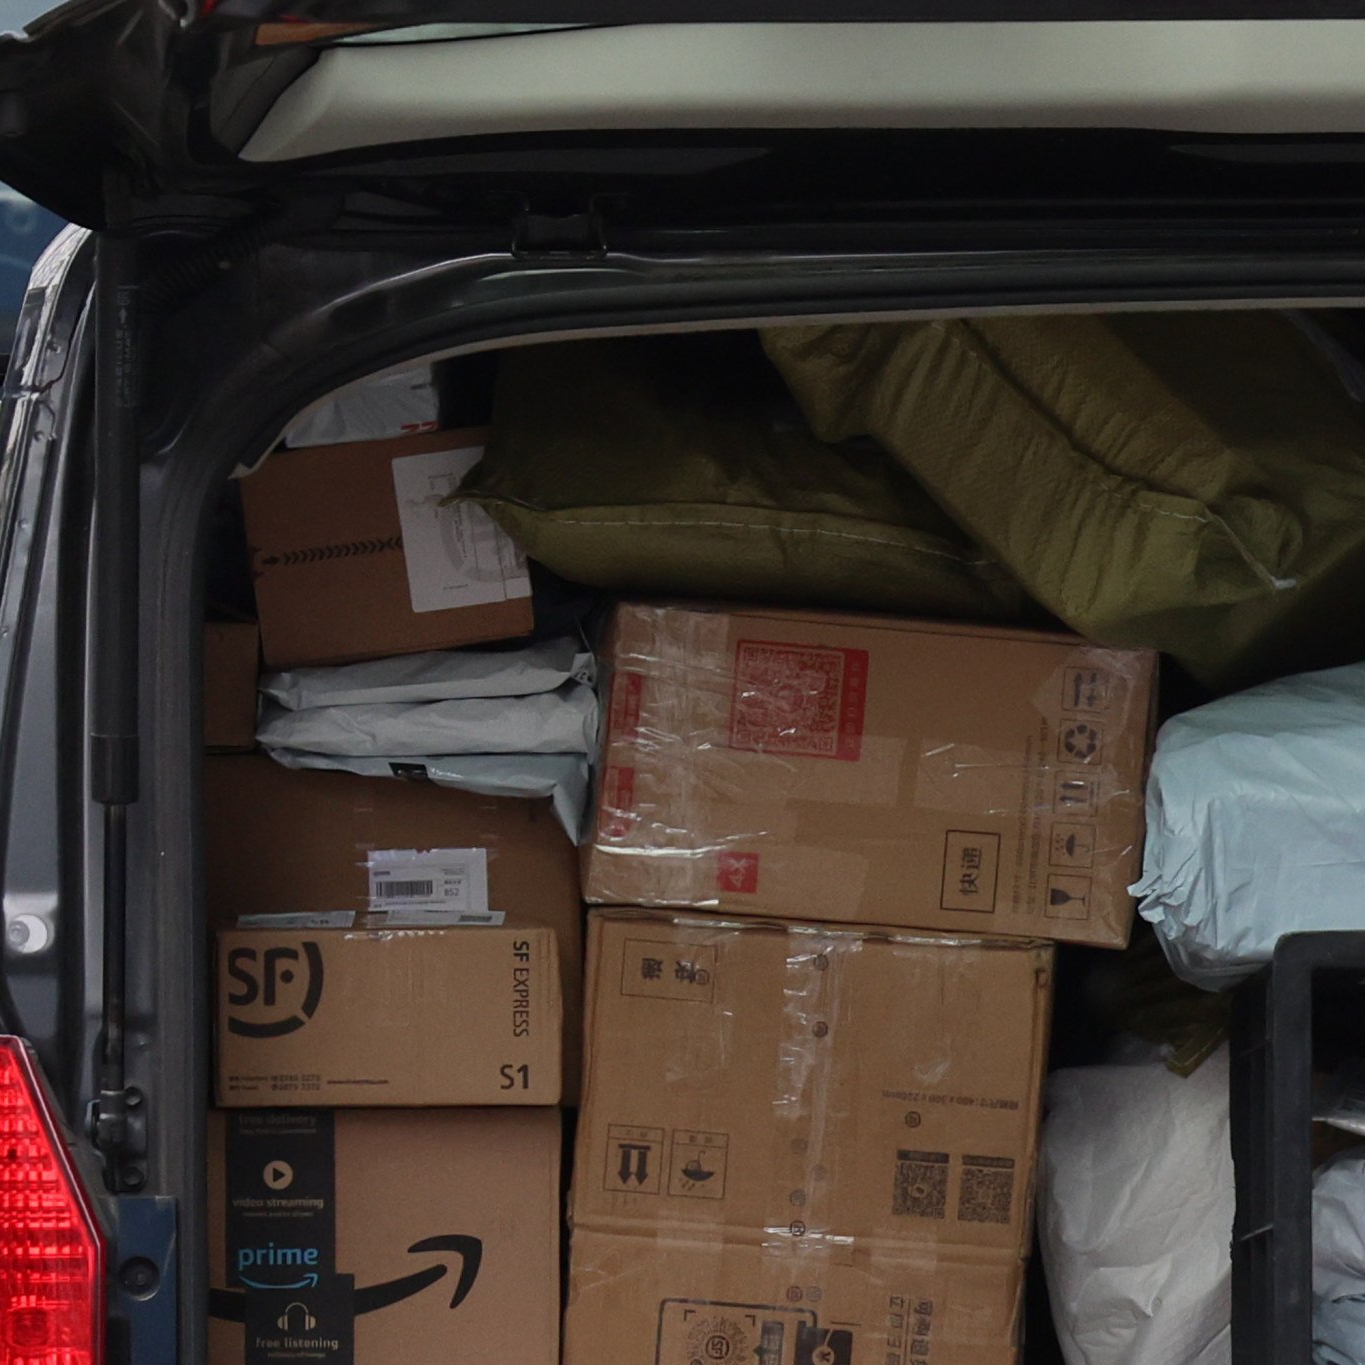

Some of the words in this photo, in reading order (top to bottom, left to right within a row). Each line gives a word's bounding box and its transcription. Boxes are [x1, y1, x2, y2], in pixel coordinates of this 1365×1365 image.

[513, 940, 530, 962] SF
[227, 946, 299, 1007] SF
[513, 969, 530, 1037] EXPRESS
[500, 1064, 530, 1090] S1
[232, 1197, 264, 1208] video
[266, 1196, 325, 1211] streaming
[237, 1242, 319, 1269] prime
[255, 1337, 280, 1348] free
[284, 1336, 339, 1352] listening
